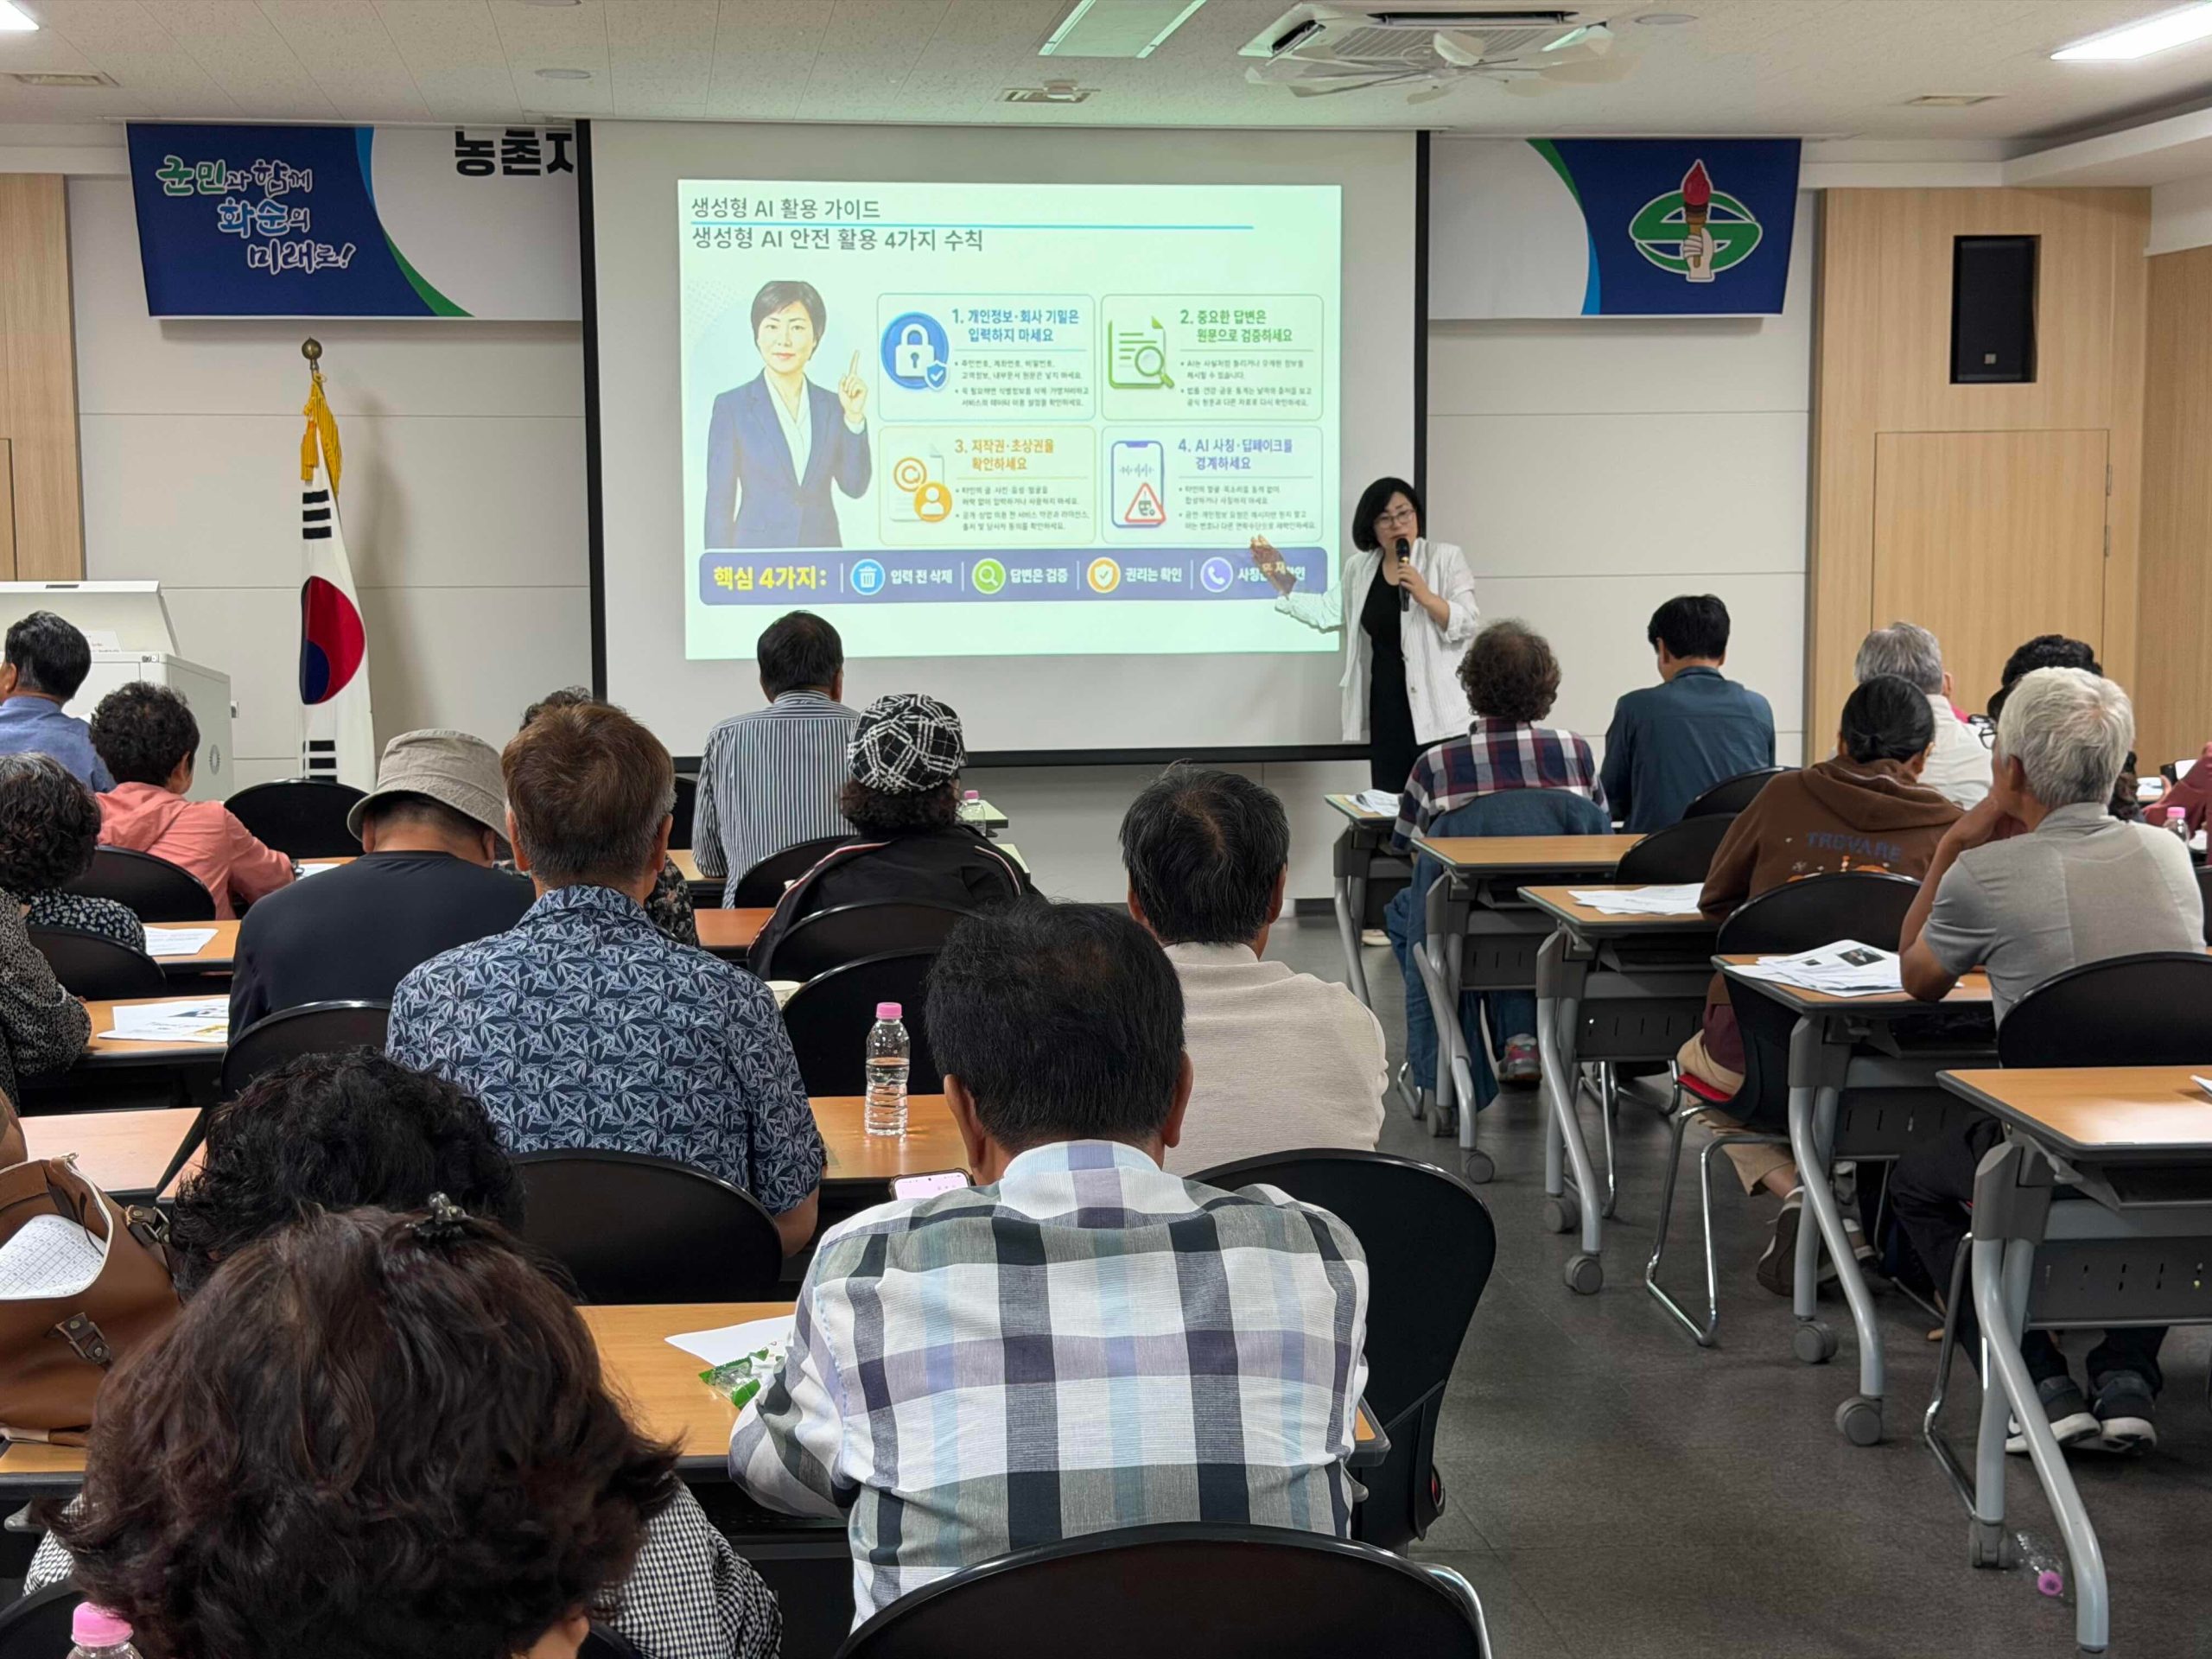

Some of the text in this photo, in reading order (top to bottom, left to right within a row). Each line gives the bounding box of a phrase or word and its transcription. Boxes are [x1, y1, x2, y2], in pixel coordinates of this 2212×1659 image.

[156, 155, 313, 199] 군민과 함께
[691, 197, 880, 220] 생성형 AI 활용 가이드
[217, 196, 310, 238] 화순의
[691, 226, 983, 251] 생성형 AI 안전 활용 4가지 수칙
[247, 238, 356, 275] 미래로!
[952, 308, 964, 324] 1.
[1046, 309, 1079, 324] 기밀은
[1180, 309, 1267, 325] 2. 중요한 답변은
[968, 327, 1053, 342] 입력하지 마세요
[1197, 328, 1293, 343] 원문으로 검증하세요
[955, 439, 968, 454] 3.
[1178, 438, 1192, 453] 4.
[1195, 439, 1209, 452] AI
[972, 456, 1027, 471] 확인하세요
[1196, 456, 1250, 470] 경계하세요
[714, 566, 827, 591] 핵심 4가지:
[891, 569, 952, 584] 입력 전 삭제
[1010, 568, 1067, 583] 답변은 검증
[1125, 567, 1182, 582] 권리는 확인
